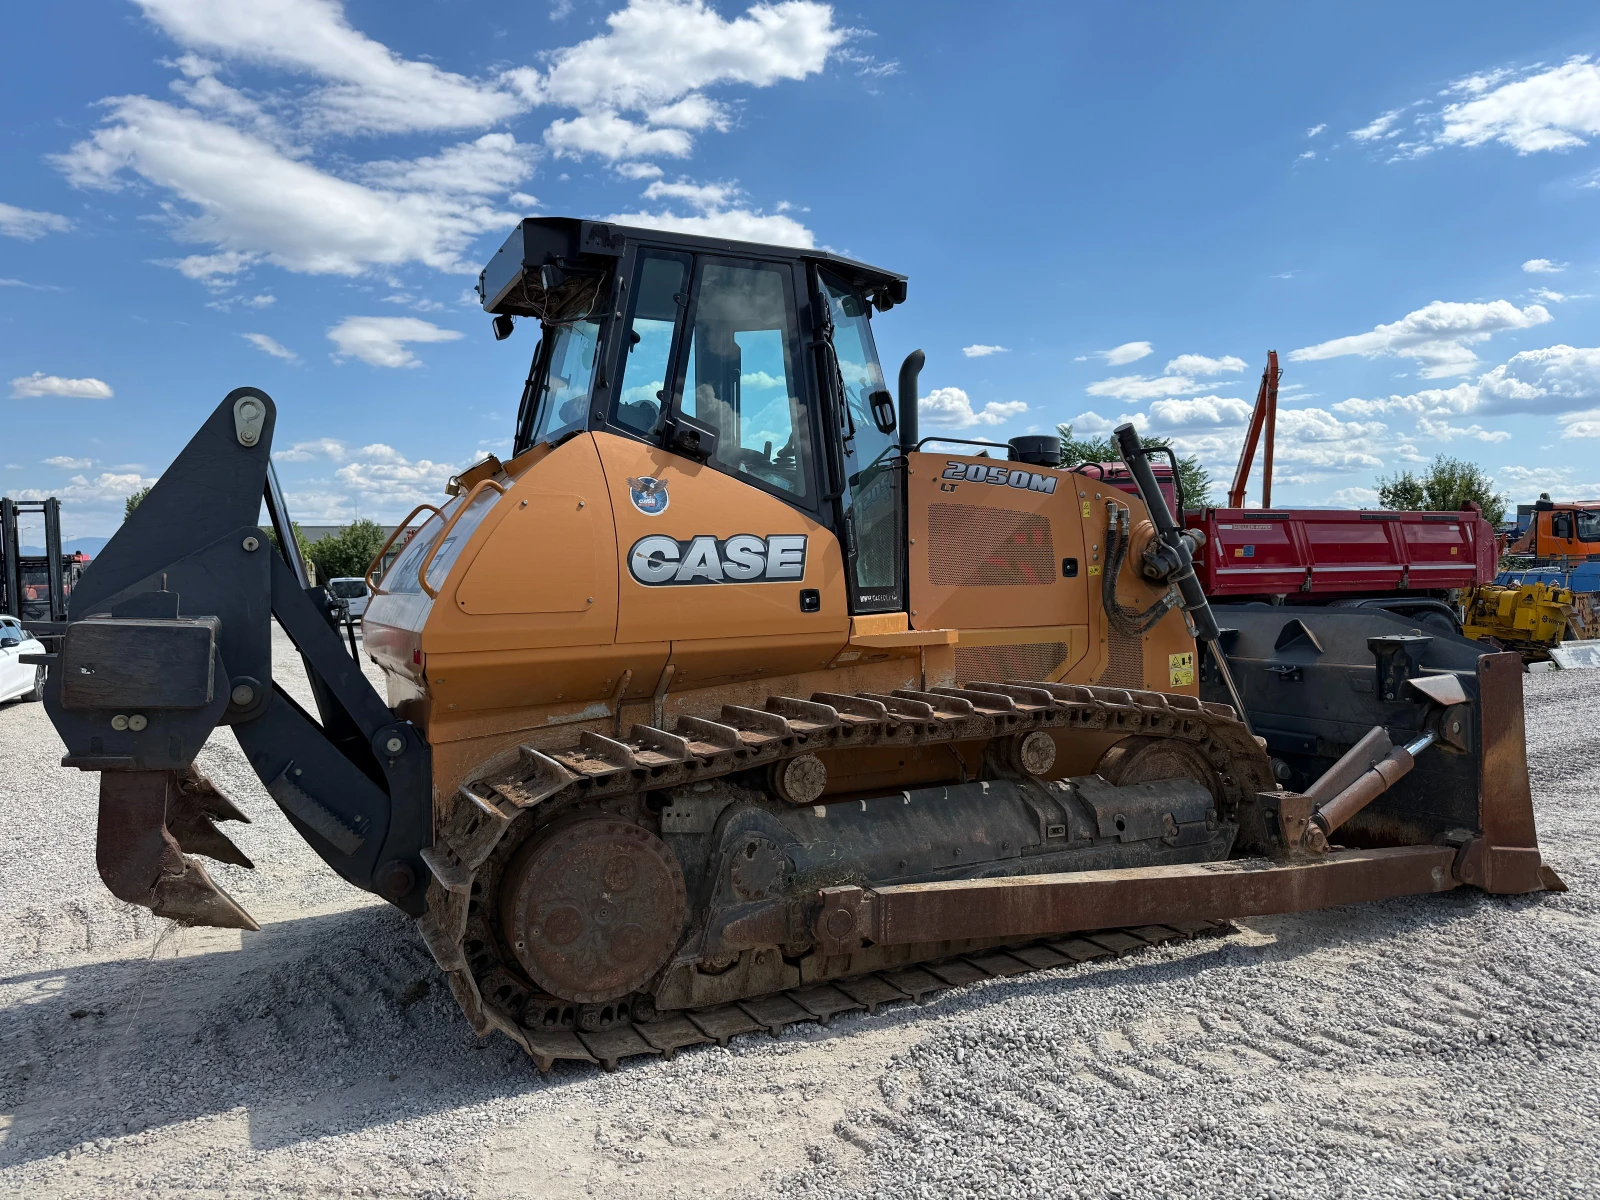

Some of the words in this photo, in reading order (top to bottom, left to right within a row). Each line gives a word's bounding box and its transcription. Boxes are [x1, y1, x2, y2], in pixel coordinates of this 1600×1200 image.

[941, 483, 959, 492] LT
[942, 461, 1058, 494] 2050M
[630, 534, 806, 583] CASE
